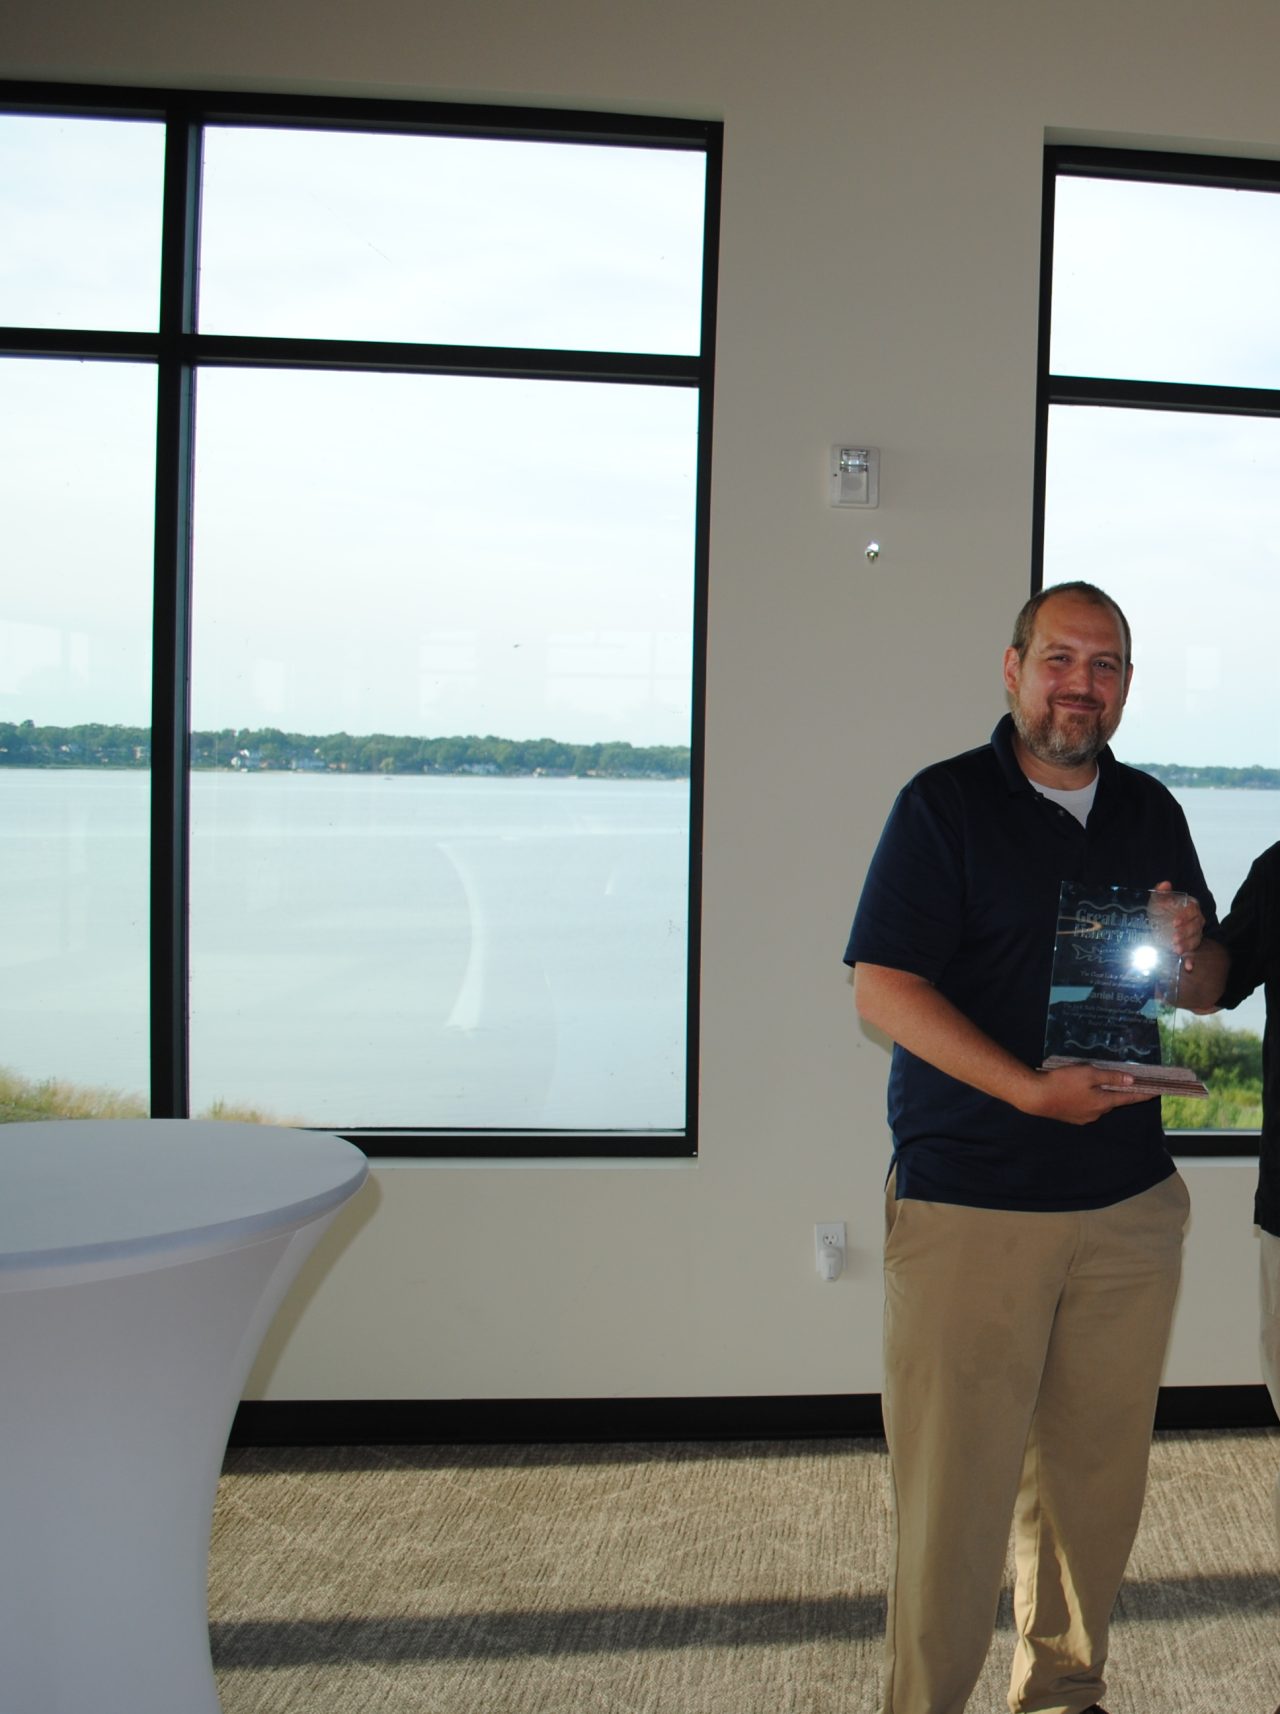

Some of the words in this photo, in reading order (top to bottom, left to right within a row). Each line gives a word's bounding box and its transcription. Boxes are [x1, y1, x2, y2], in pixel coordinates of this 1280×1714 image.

[1076, 908, 1116, 926] Great
[1089, 990, 1114, 1001] aniel
[1116, 992, 1141, 1004] Bock
